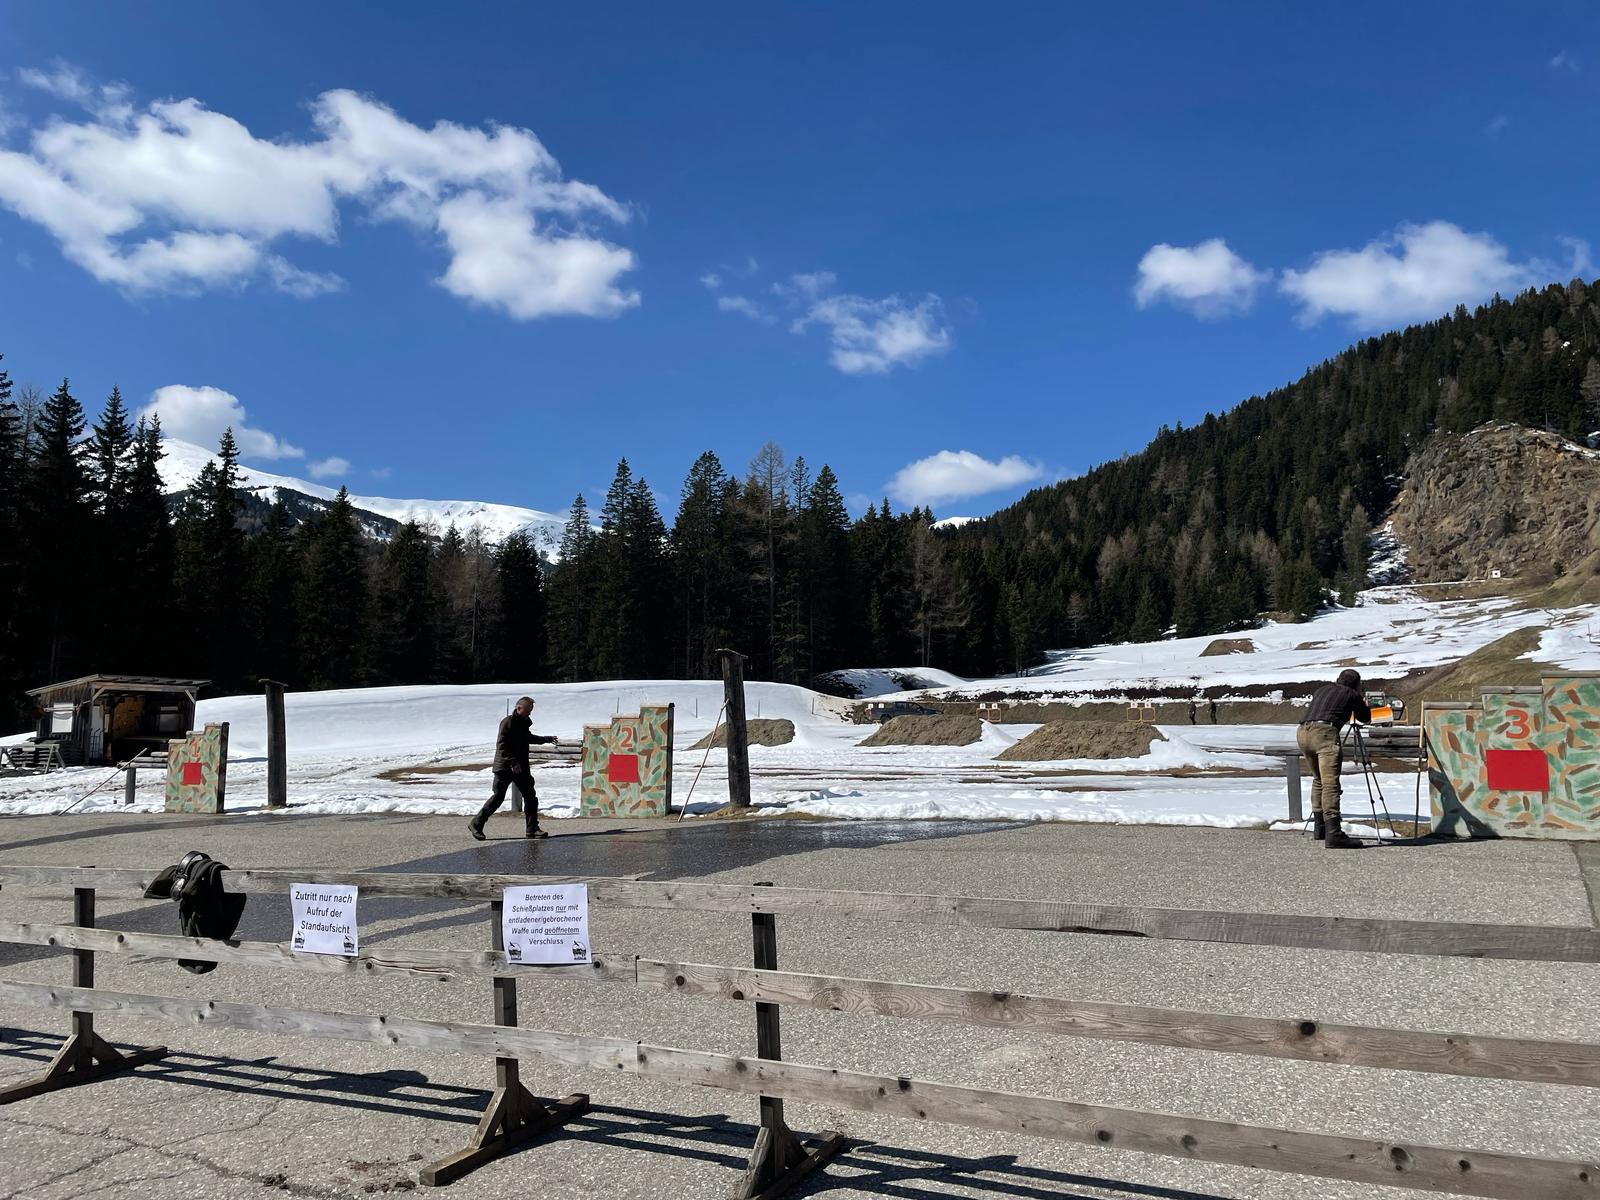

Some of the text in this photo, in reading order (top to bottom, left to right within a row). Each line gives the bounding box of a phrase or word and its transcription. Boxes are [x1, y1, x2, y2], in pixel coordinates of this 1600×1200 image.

[1505, 709, 1530, 740] 3
[620, 726, 633, 748] 2
[191, 738, 201, 758] 1
[295, 890, 353, 904] Zutritt nur nach
[525, 893, 564, 901] Betreten des
[306, 906, 343, 918] Aufruf der
[512, 904, 554, 913] Schießplatzes
[300, 920, 350, 934] Standaufsicht
[511, 927, 530, 935] Waffe
[544, 926, 580, 935] geöffnetem
